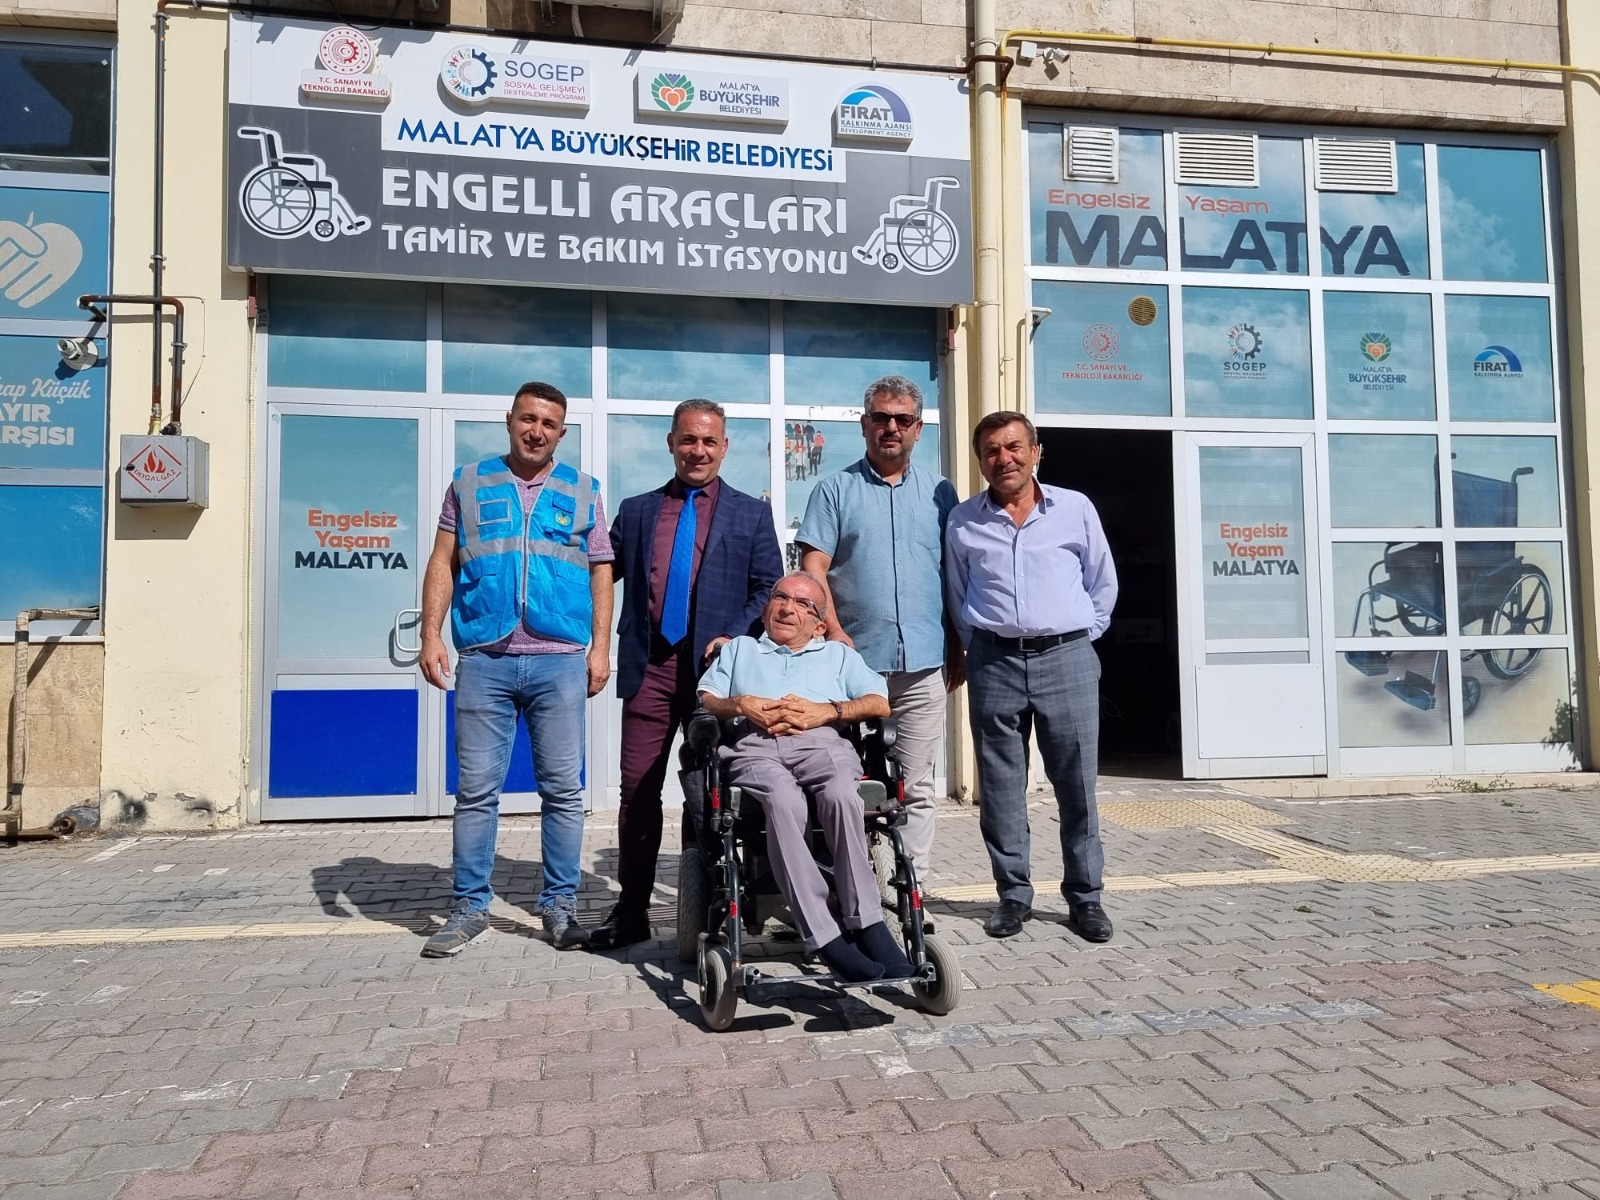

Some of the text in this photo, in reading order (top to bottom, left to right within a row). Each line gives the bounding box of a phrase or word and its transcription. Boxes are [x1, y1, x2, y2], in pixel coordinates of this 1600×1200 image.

[504, 60, 584, 82] SOGEP
[303, 84, 388, 97] TEKNOLOJİ BAKANLIĞI
[334, 78, 361, 86] SANAYİ
[504, 81, 585, 94] SOSYAL GELİŞMEYİ
[719, 81, 761, 93] MALATYA
[504, 89, 586, 101] DESTEKLEME PROGRAMI
[699, 89, 781, 107] BÜYÜKŞEHİR
[719, 104, 762, 115] BELEDİYESİ
[840, 105, 892, 121] FIRAT
[841, 120, 912, 130] KALKINMA AJANSI
[841, 127, 884, 136] DEVELOPMENT
[397, 117, 834, 172] MALATYA BÜYÜKŞEHİR BELEDİYESİ
[382, 168, 847, 237] ENGELLİ ARAÇLARI
[1047, 188, 1269, 218] Engelsiz Yaşam
[381, 222, 847, 275] TAMİR VE BAKIM İSTASYONU
[1045, 210, 1411, 276] MALATYA
[1223, 361, 1267, 371] SOGEP
[1473, 361, 1509, 372] FIRAT
[31, 378, 91, 404] Küçük
[0, 402, 52, 423] YIR
[0, 425, 74, 448] RŞISI
[308, 509, 398, 532] Engelsiz
[315, 530, 390, 553] Yaşam
[1219, 522, 1288, 542] Engelsiz
[294, 551, 408, 570] MALATYA
[1226, 541, 1284, 561] Yaşam
[1212, 559, 1299, 577] MALATYA
